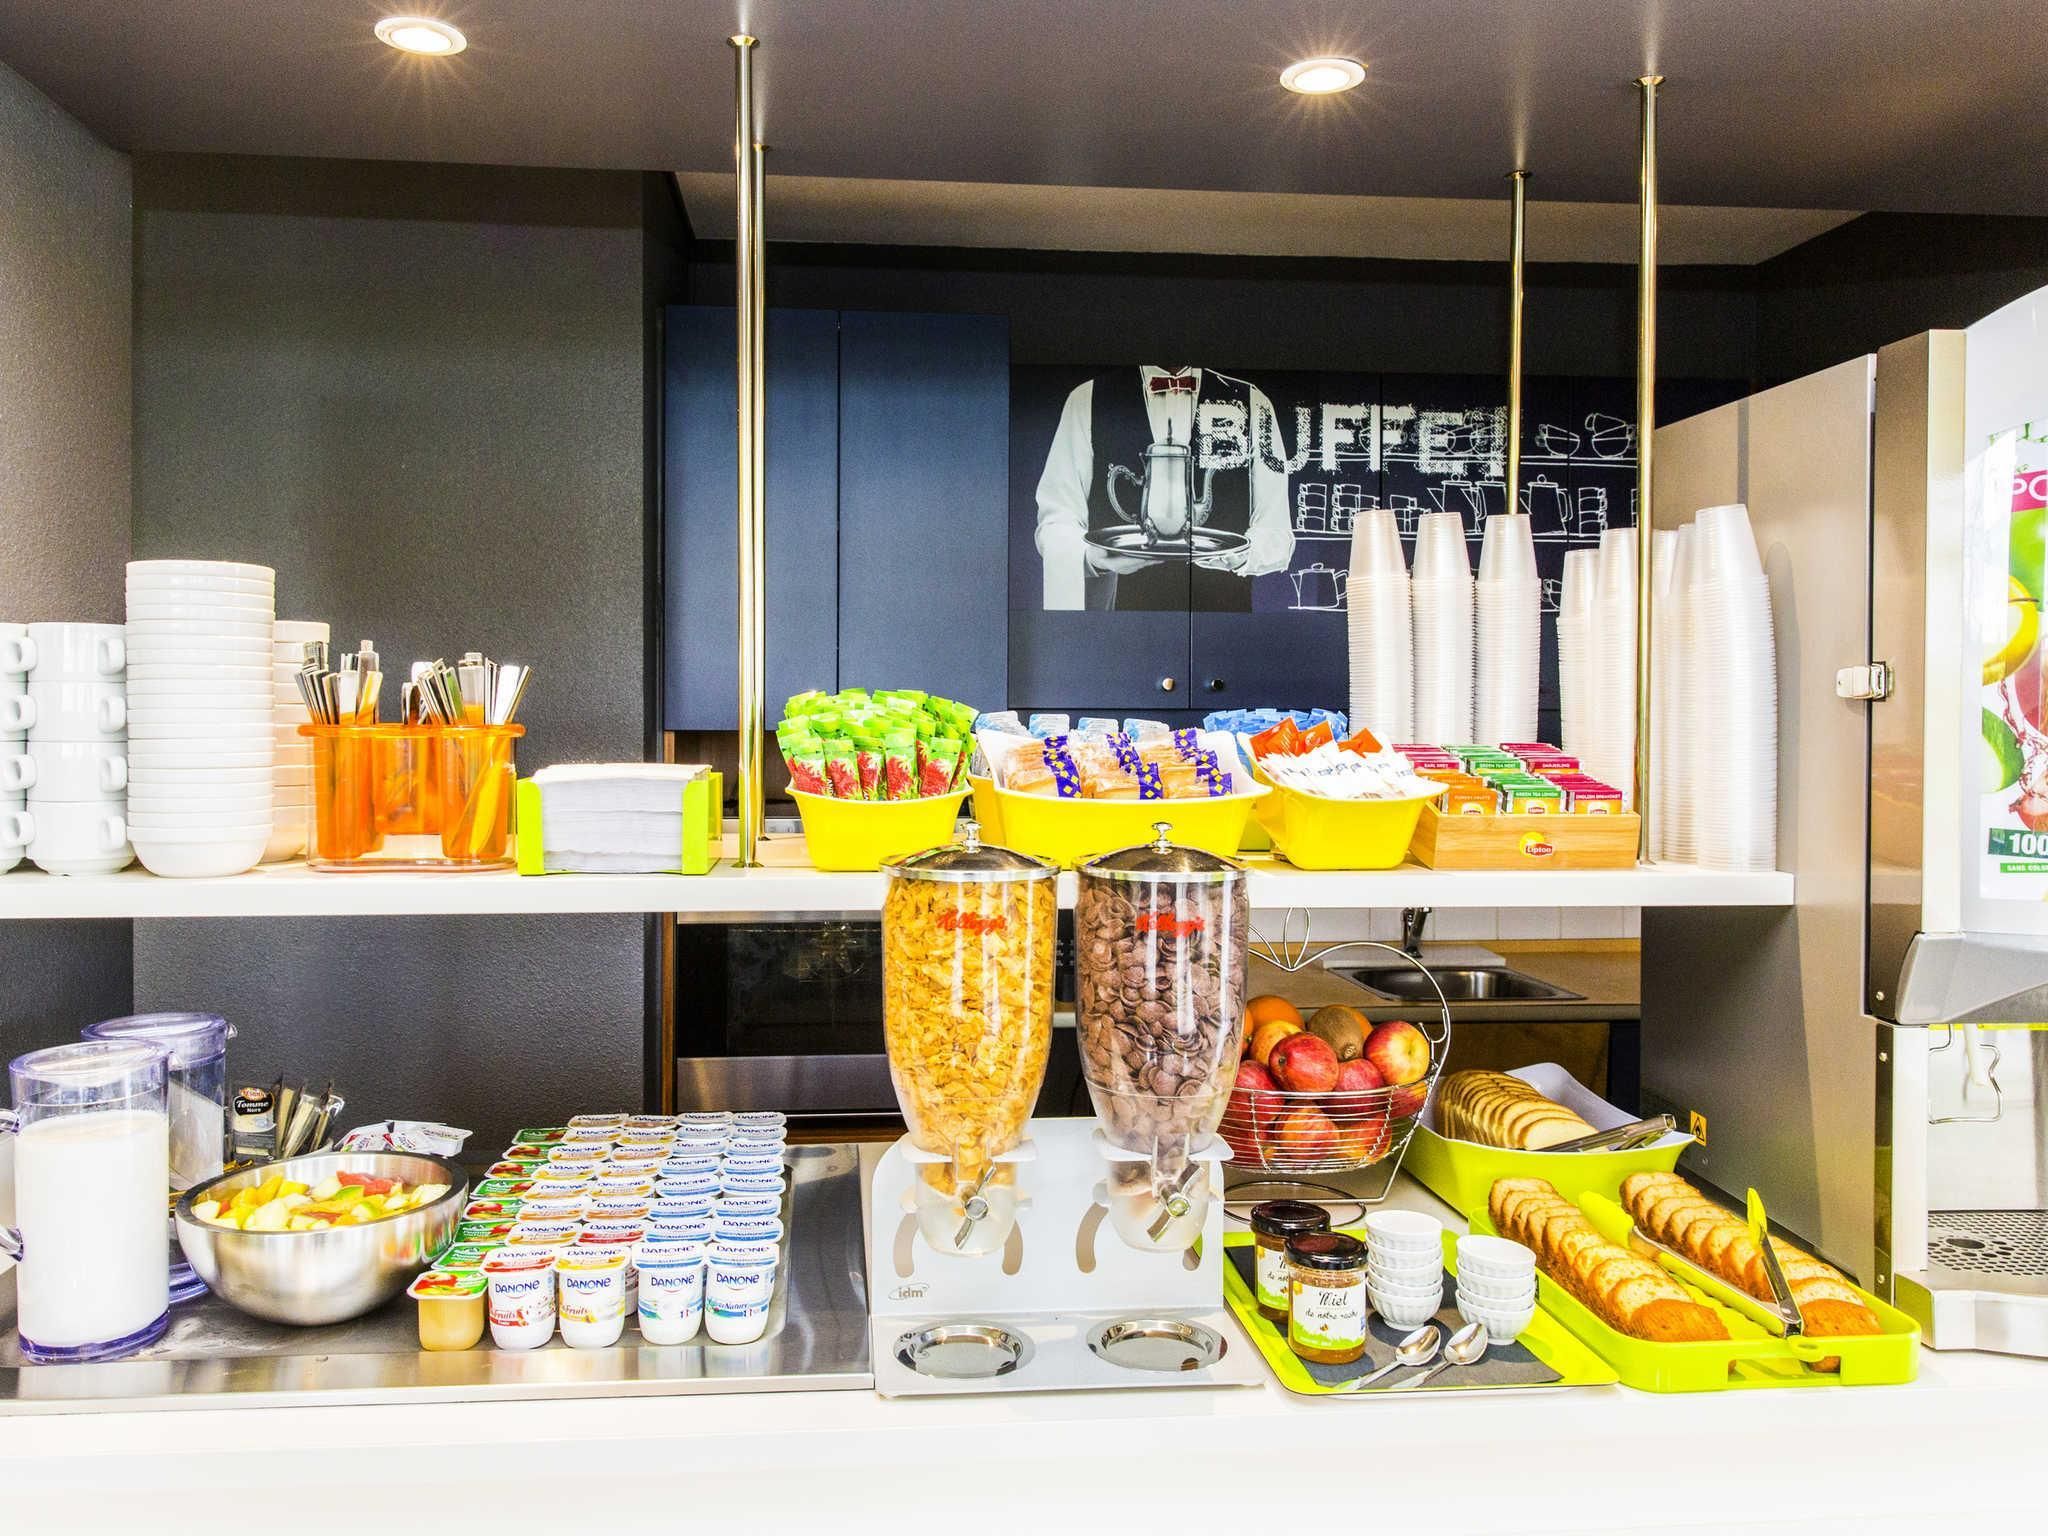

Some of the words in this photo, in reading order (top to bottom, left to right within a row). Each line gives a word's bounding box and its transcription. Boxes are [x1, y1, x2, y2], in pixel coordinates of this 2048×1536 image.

[1197, 399, 1507, 476] BUFFET
[1526, 846, 1552, 854] Lipton
[936, 909, 1007, 936] Kellogg's
[1136, 912, 1205, 937] Kellogg's
[236, 1100, 269, 1108] Tomme
[654, 1221, 706, 1231] DANONE
[722, 1218, 774, 1228] DANONE
[641, 1244, 694, 1254] DANONE
[716, 1244, 769, 1254] DANONE
[567, 1277, 612, 1288] DANONE
[651, 1274, 695, 1287] DANONE
[716, 1272, 760, 1284] DANONE
[495, 1279, 540, 1293] DANONE
[898, 1287, 923, 1298] idm
[1319, 1290, 1348, 1306] Miel
